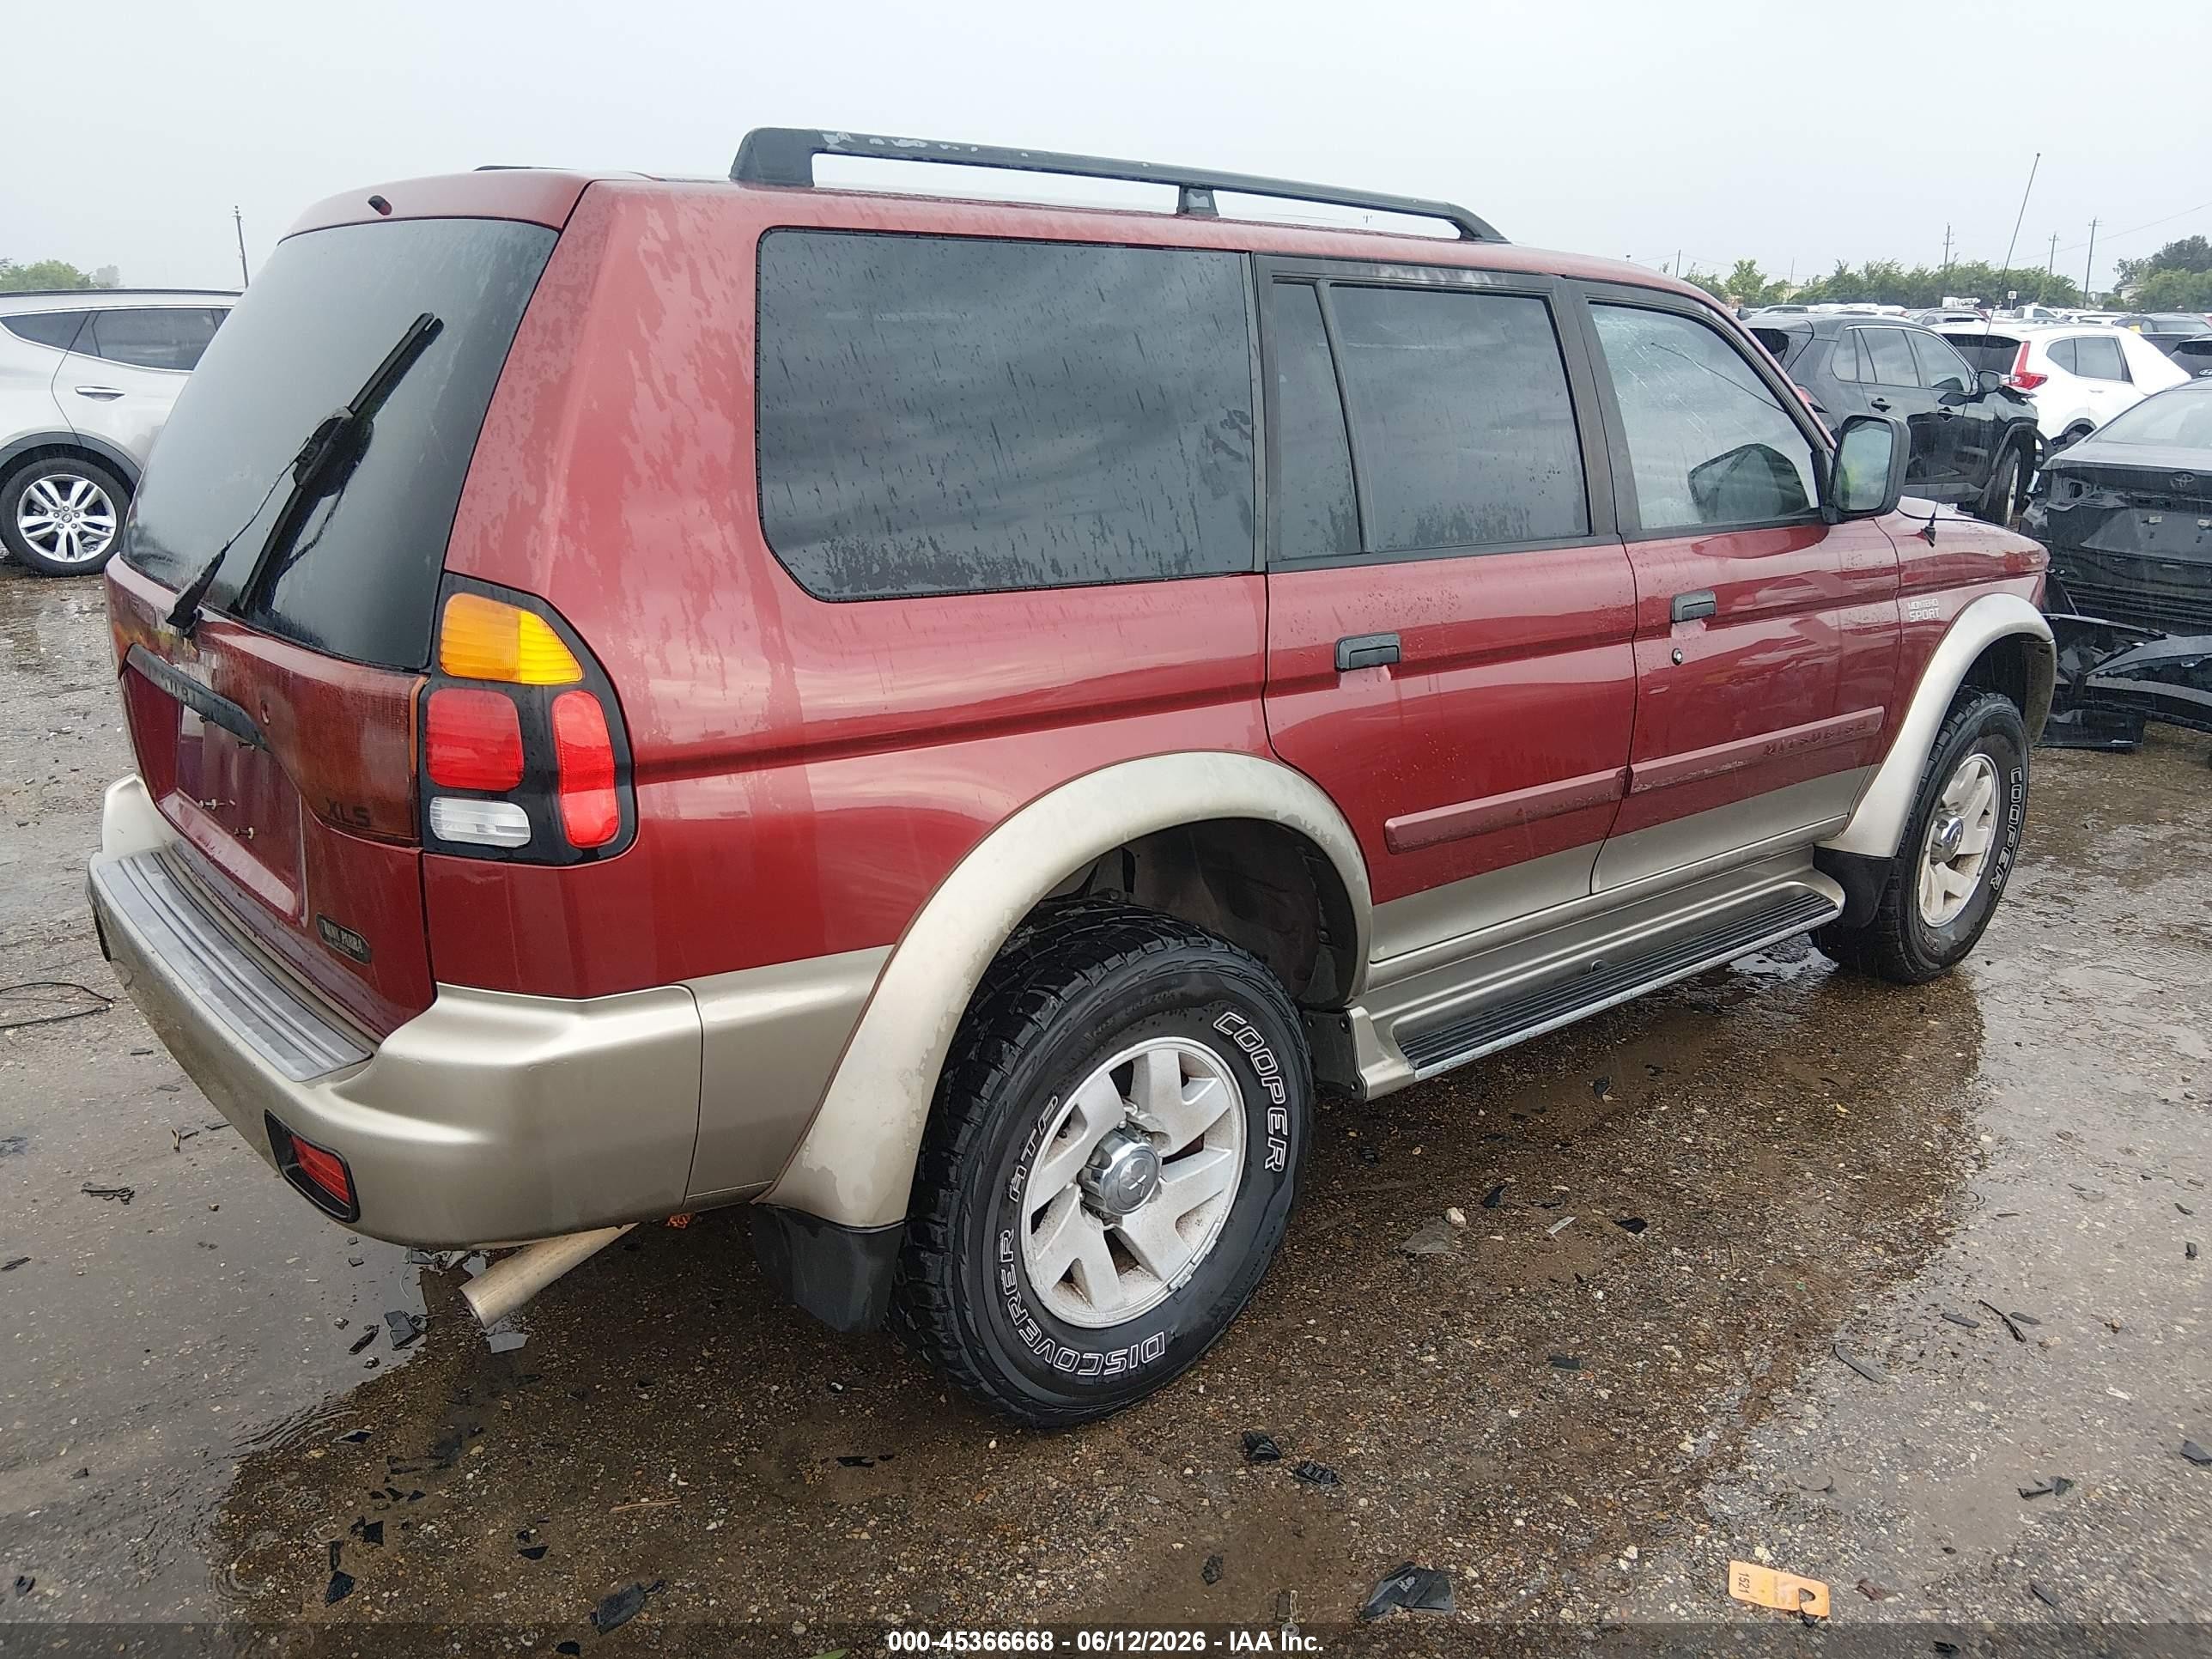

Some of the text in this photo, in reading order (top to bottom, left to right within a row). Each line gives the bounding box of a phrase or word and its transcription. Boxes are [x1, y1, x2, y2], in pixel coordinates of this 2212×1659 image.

[1909, 608, 1940, 622] SPORT
[325, 797, 371, 828] XLS
[1990, 767, 2022, 890] COOPER
[1212, 1012, 1288, 1173] COOPER
[1000, 1228, 1166, 1376] DISCOVERER
[1737, 1571, 1751, 1595] 1521
